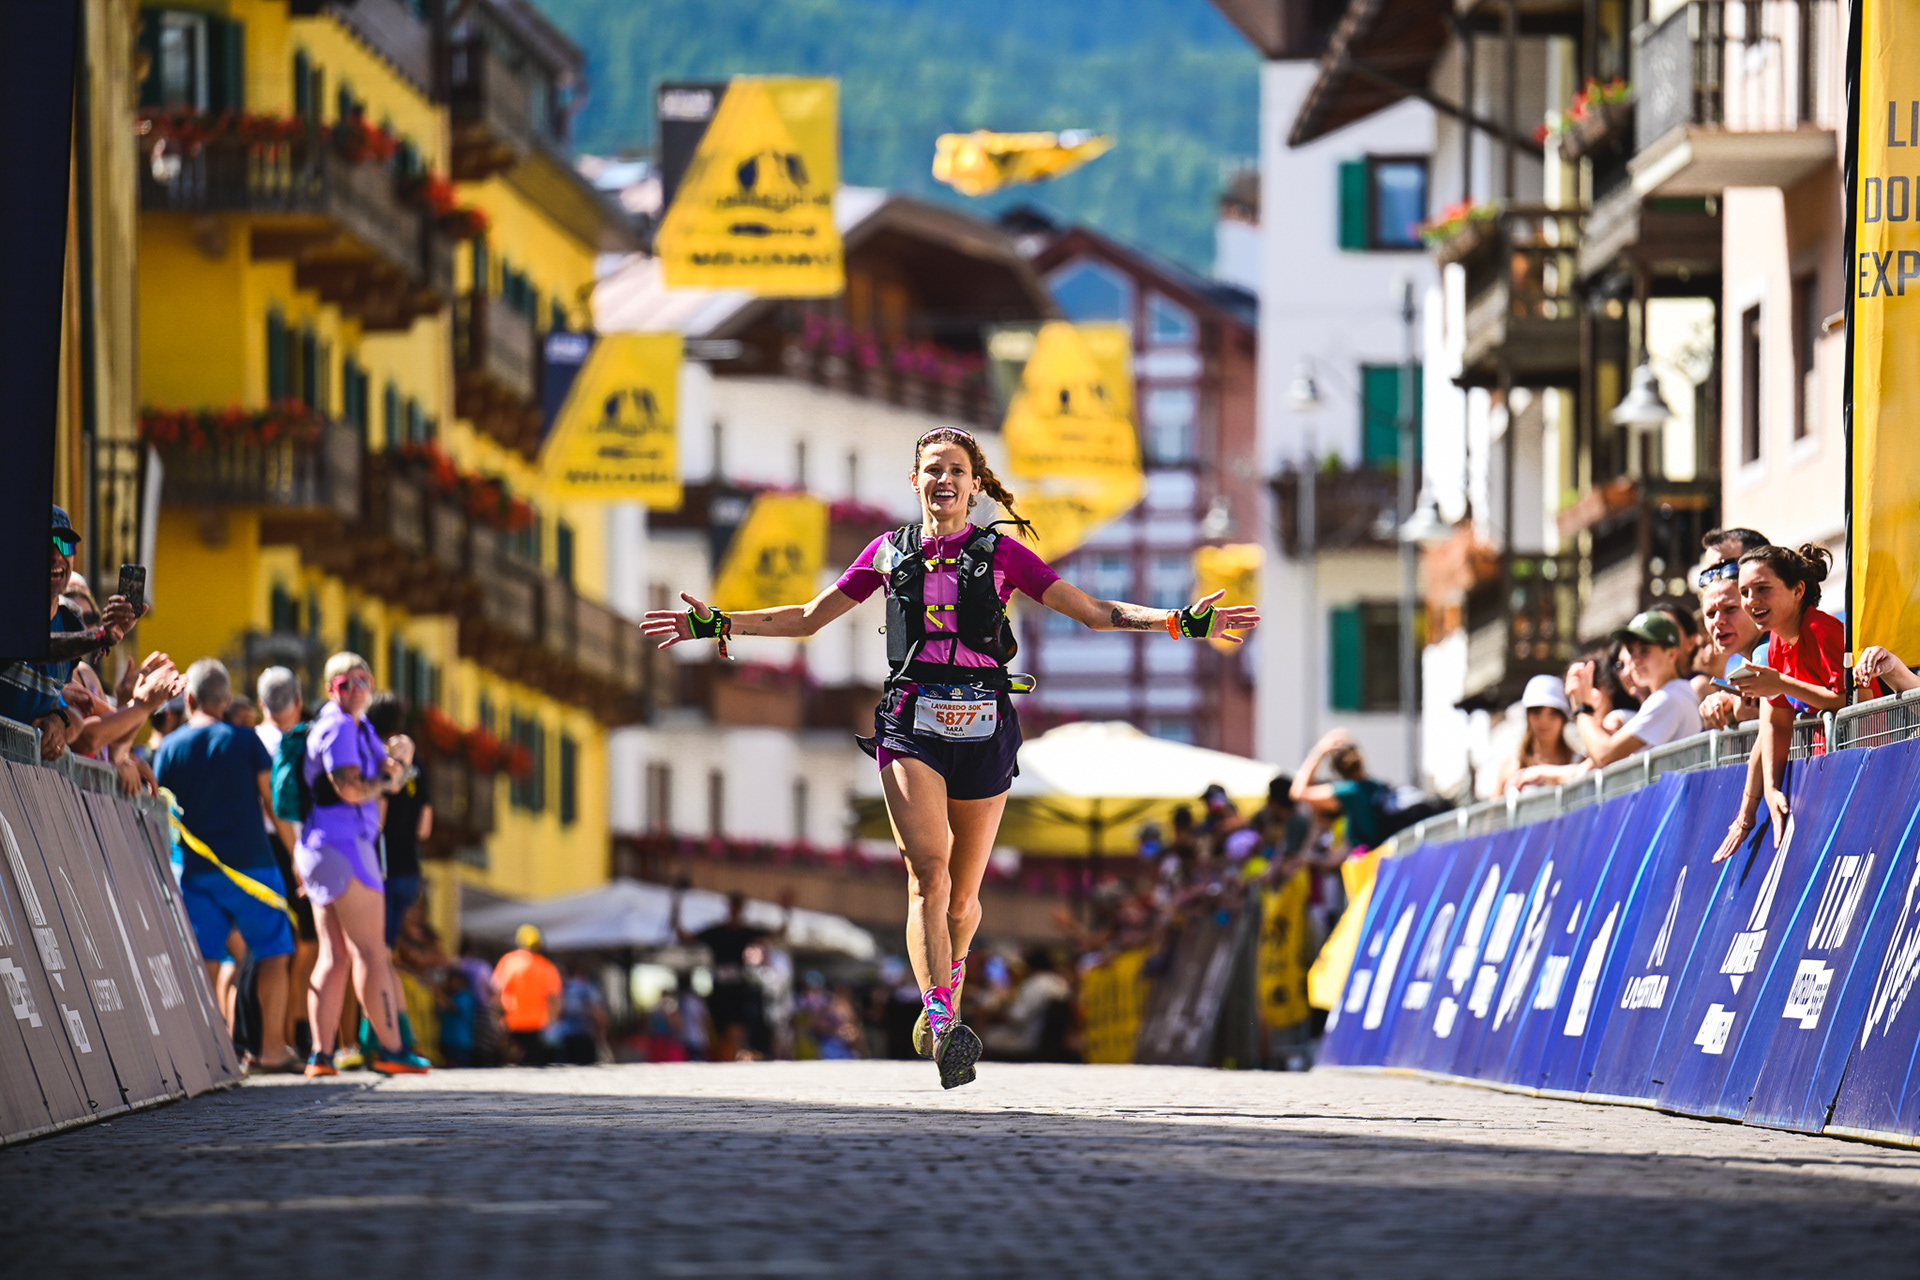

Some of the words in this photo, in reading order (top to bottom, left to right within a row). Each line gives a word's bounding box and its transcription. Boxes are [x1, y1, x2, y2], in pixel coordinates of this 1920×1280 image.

[1864, 175, 1920, 223] DO
[931, 703, 966, 711] LAVAREDO
[936, 712, 976, 726] 5877
